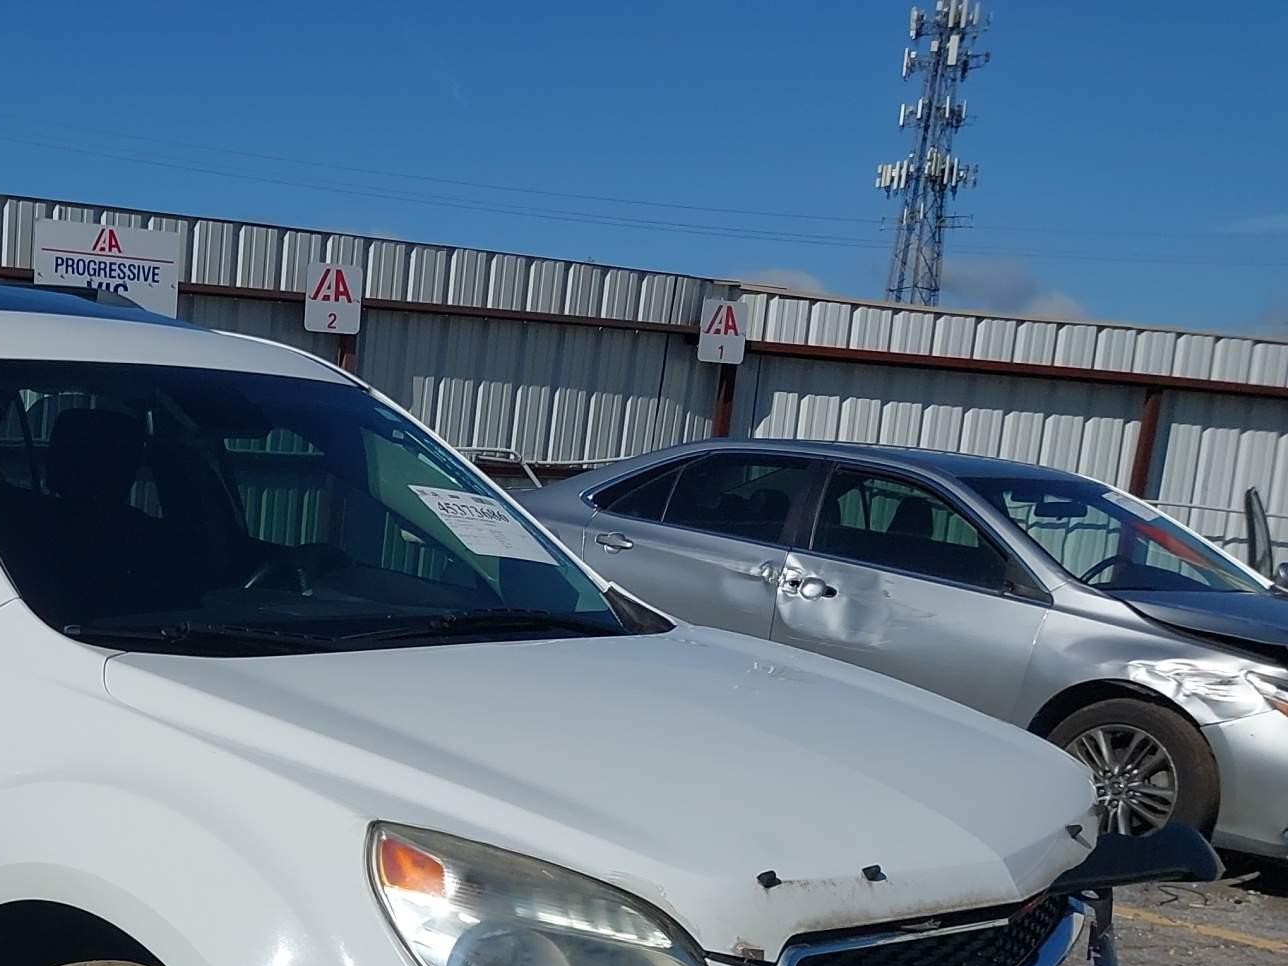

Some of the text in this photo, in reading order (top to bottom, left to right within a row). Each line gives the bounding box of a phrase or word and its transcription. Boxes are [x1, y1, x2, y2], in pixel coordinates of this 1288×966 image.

[54, 256, 161, 284] PROGRESSIVE
[327, 312, 337, 329] 2
[718, 345, 724, 360] 1
[437, 501, 510, 523] 45373686
